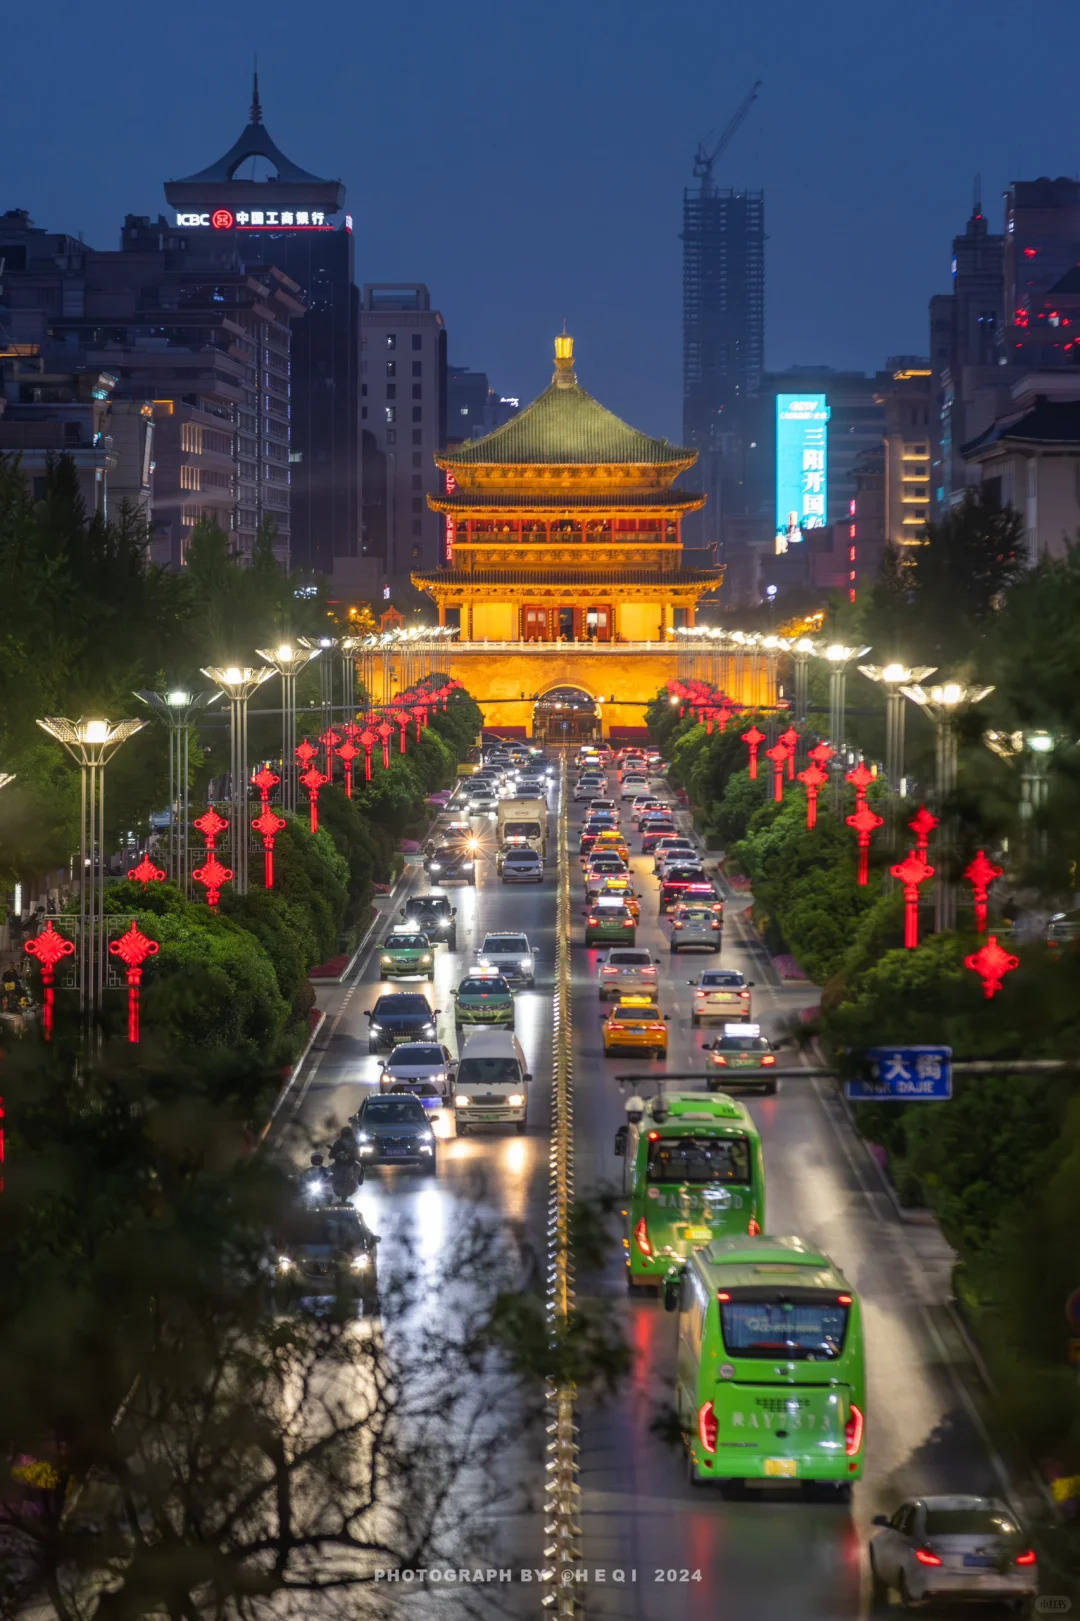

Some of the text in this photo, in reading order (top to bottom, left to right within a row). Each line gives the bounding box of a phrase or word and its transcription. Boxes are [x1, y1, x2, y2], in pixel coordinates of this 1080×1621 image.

[176, 213, 210, 226] ICBC
[235, 211, 325, 226] 中国工商银行
